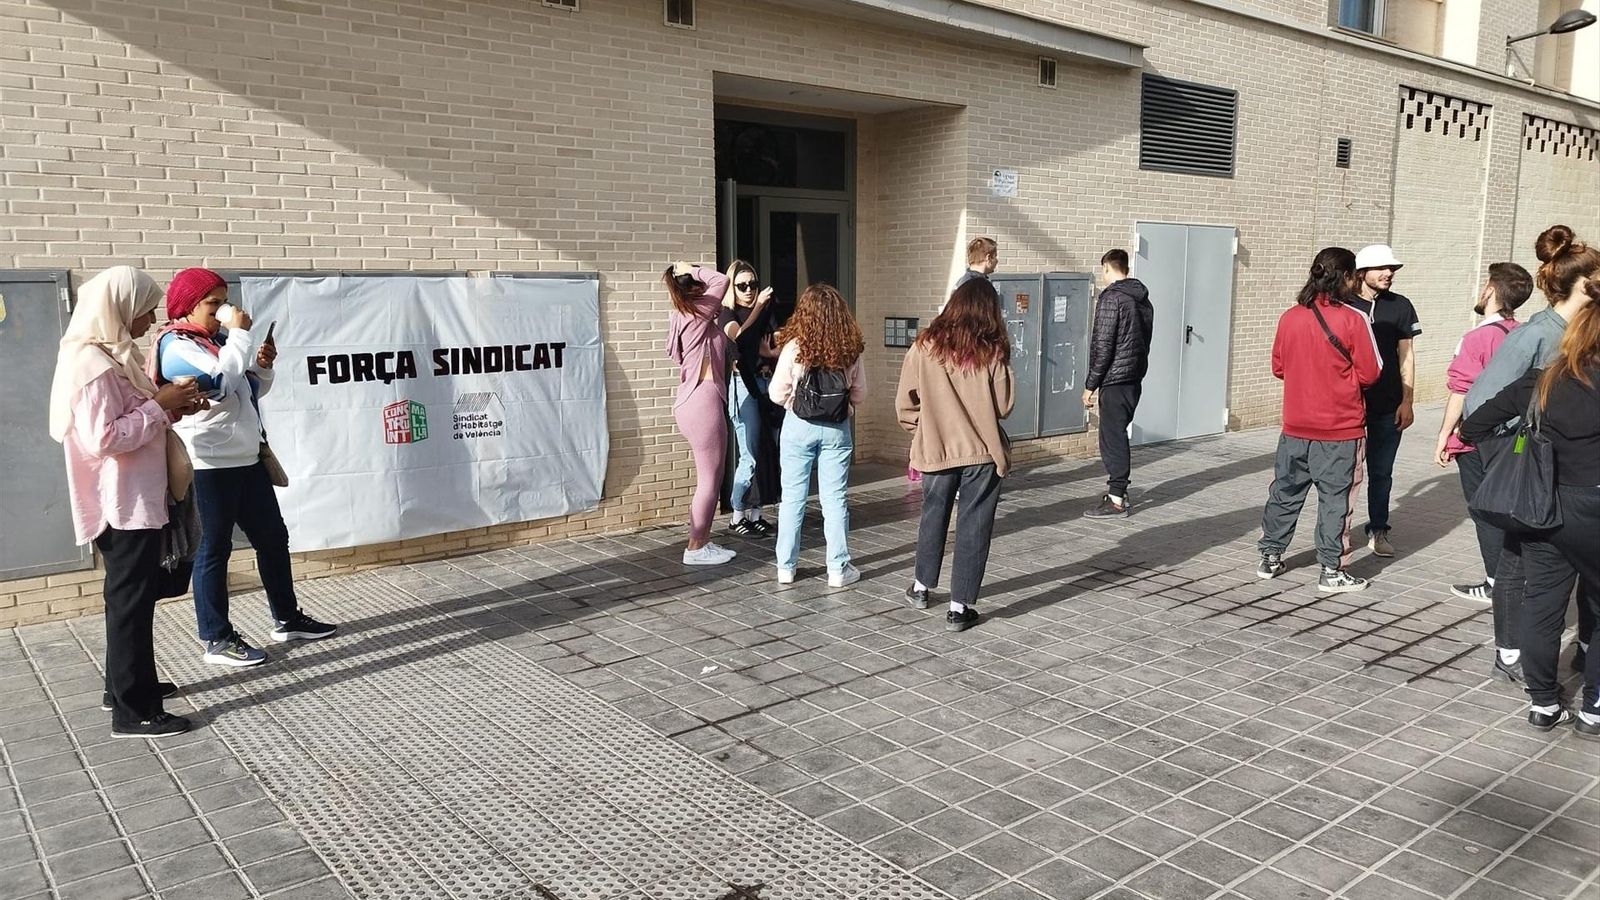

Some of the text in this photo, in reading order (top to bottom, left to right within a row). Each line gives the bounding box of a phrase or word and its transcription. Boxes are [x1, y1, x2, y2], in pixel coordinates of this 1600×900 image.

[307, 342, 567, 385] FORÇA SINDICAT
[453, 413, 488, 423] Sindicat
[453, 420, 503, 430] d'Habitatge
[387, 430, 410, 443] INT
[453, 430, 501, 440] de València
